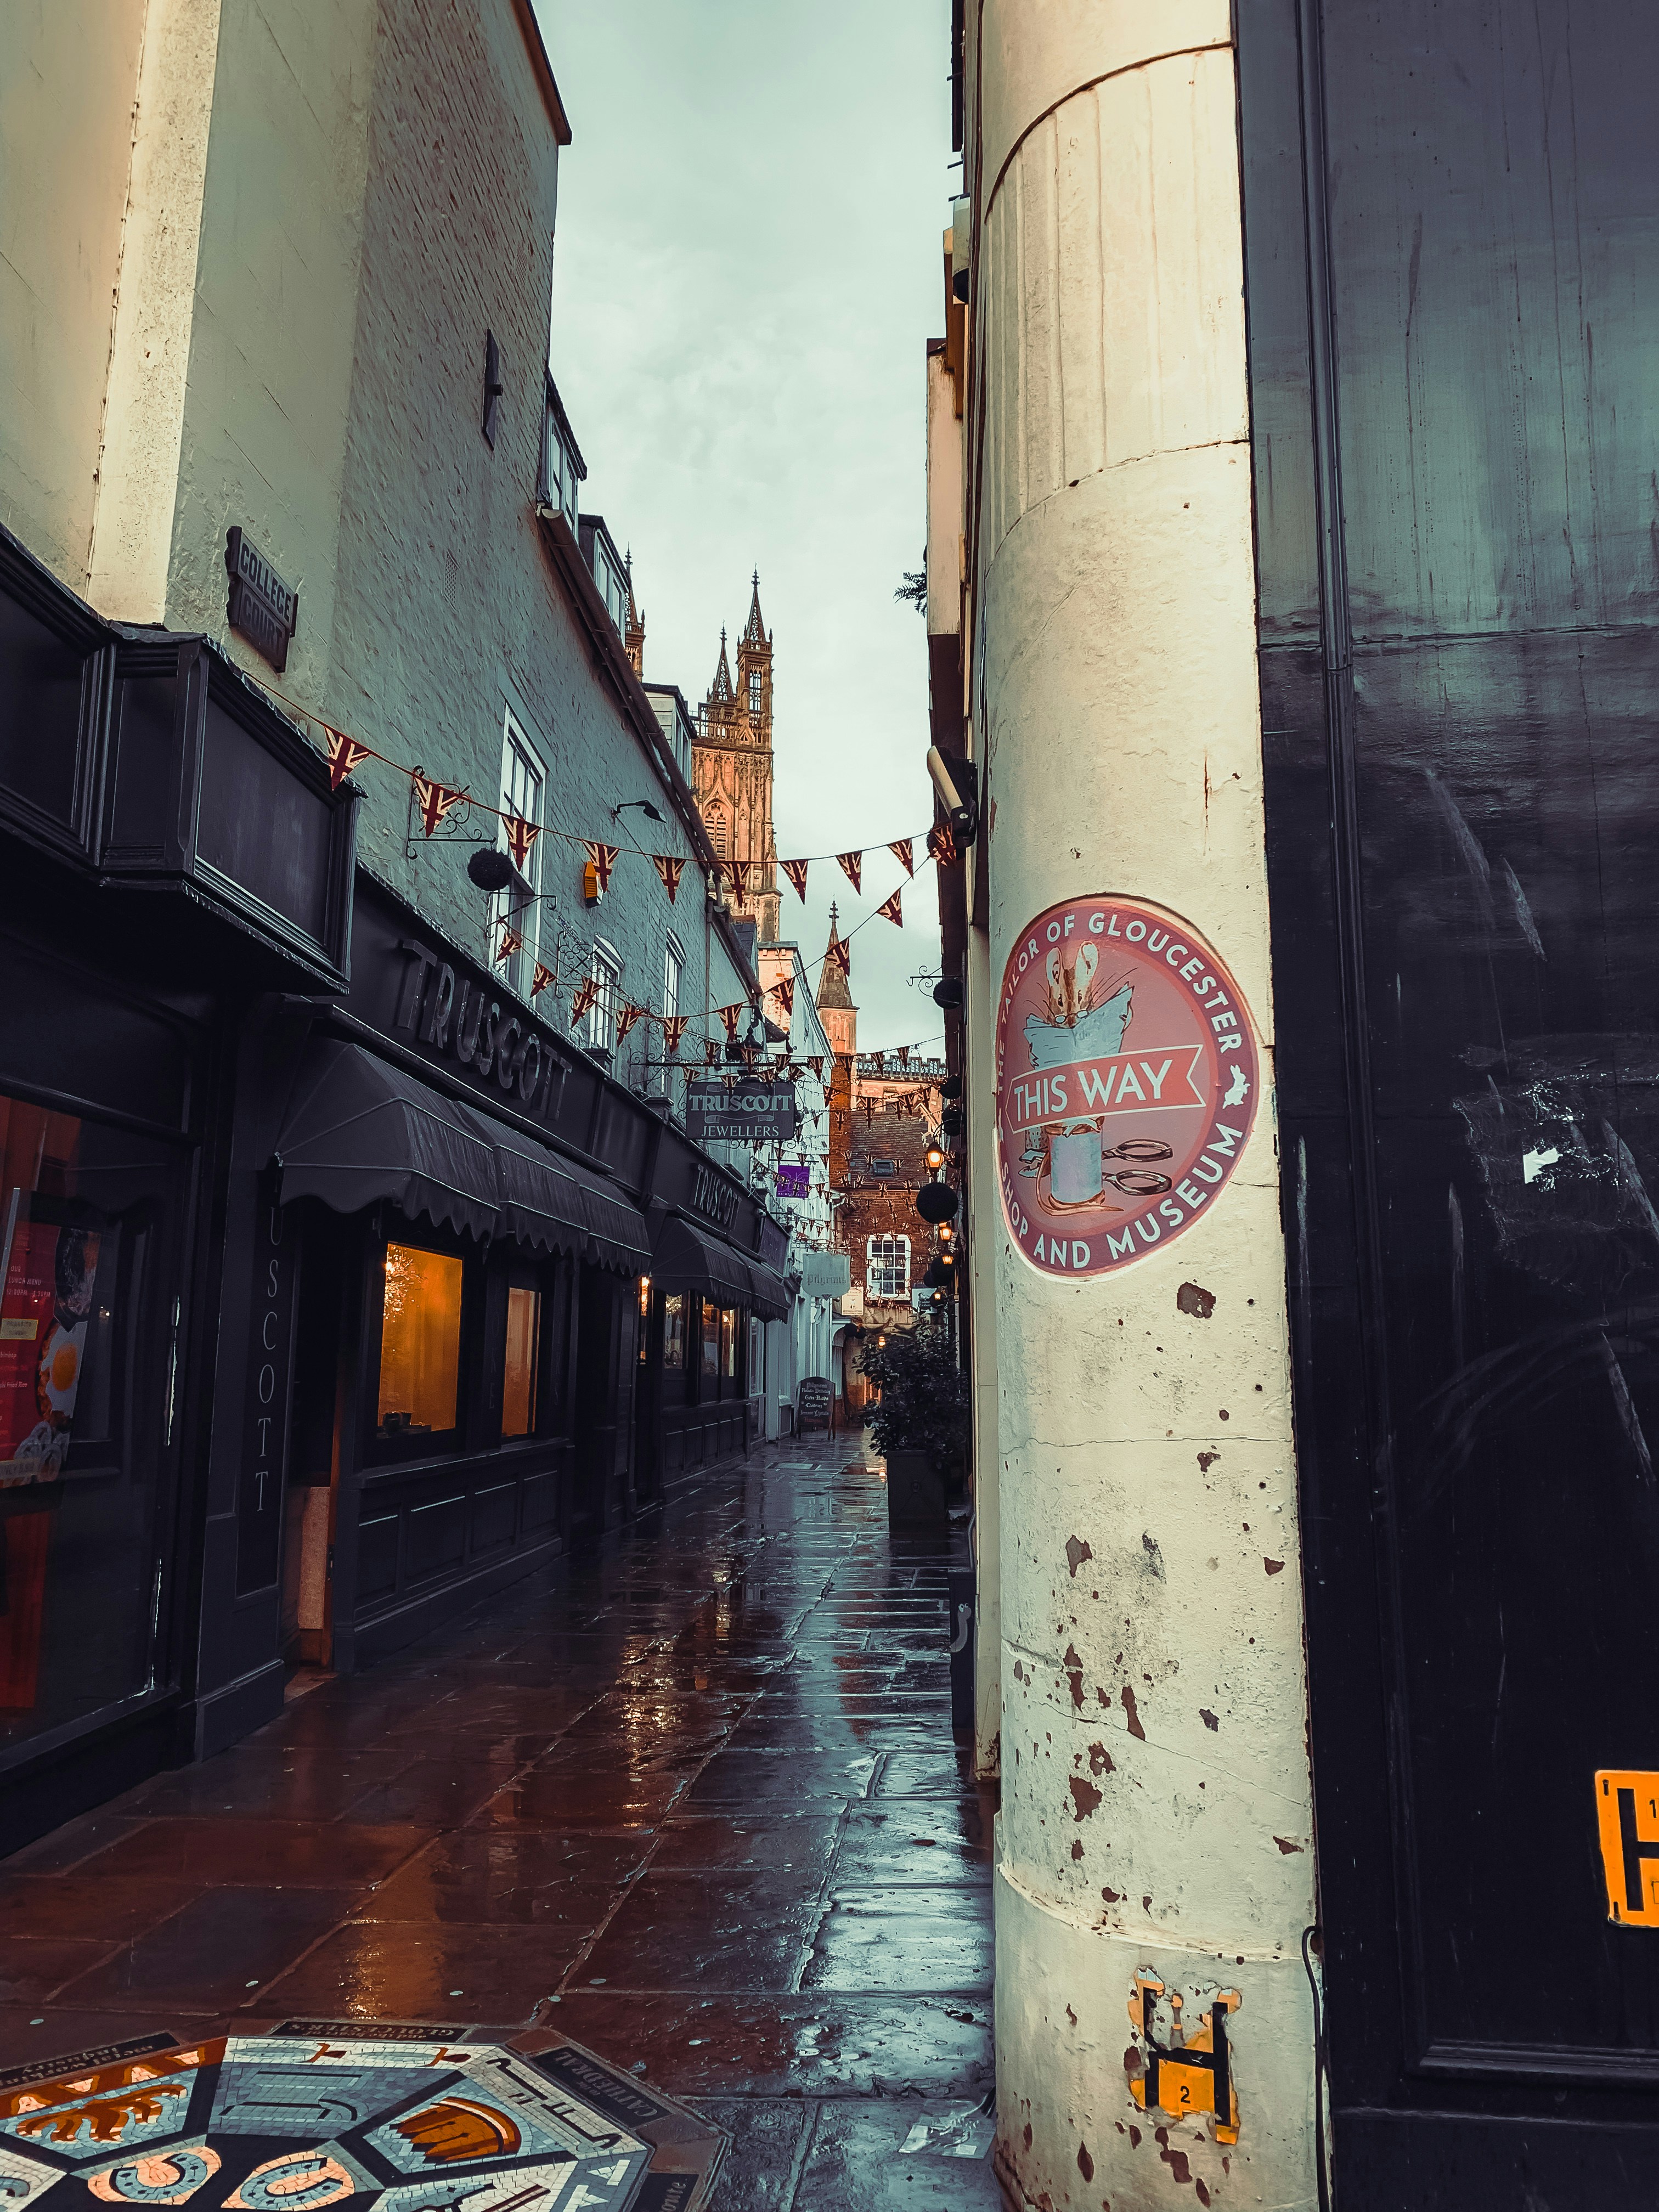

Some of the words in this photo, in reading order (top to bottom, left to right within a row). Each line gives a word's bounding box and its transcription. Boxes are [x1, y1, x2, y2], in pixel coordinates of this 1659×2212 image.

[240, 543, 291, 623] COLLEGE
[243, 593, 284, 657] COURT
[1001, 938, 1040, 1024] TAILOR
[1047, 914, 1075, 943] OF
[1088, 912, 1239, 1054] GLOUCESTER
[397, 939, 573, 1121] TRUSCOTT
[689, 1094, 792, 1111] TRUSCOTT
[1014, 1074, 1068, 1122] THIS
[1078, 1059, 1172, 1109] WAY
[701, 1125, 779, 1137] JEWELLERS
[693, 1164, 742, 1230] TRUSCOTT
[1001, 1161, 1029, 1239] SHOP
[1034, 1237, 1091, 1269] AND
[1107, 1121, 1244, 1261] MUSEUM
[8, 1276, 26, 1284] LUNCH
[23, 2047, 119, 2075] industry
[92, 2045, 153, 2065] metal
[553, 2051, 657, 2117] CATHEDRAL
[1180, 2085, 1190, 2104] 2
